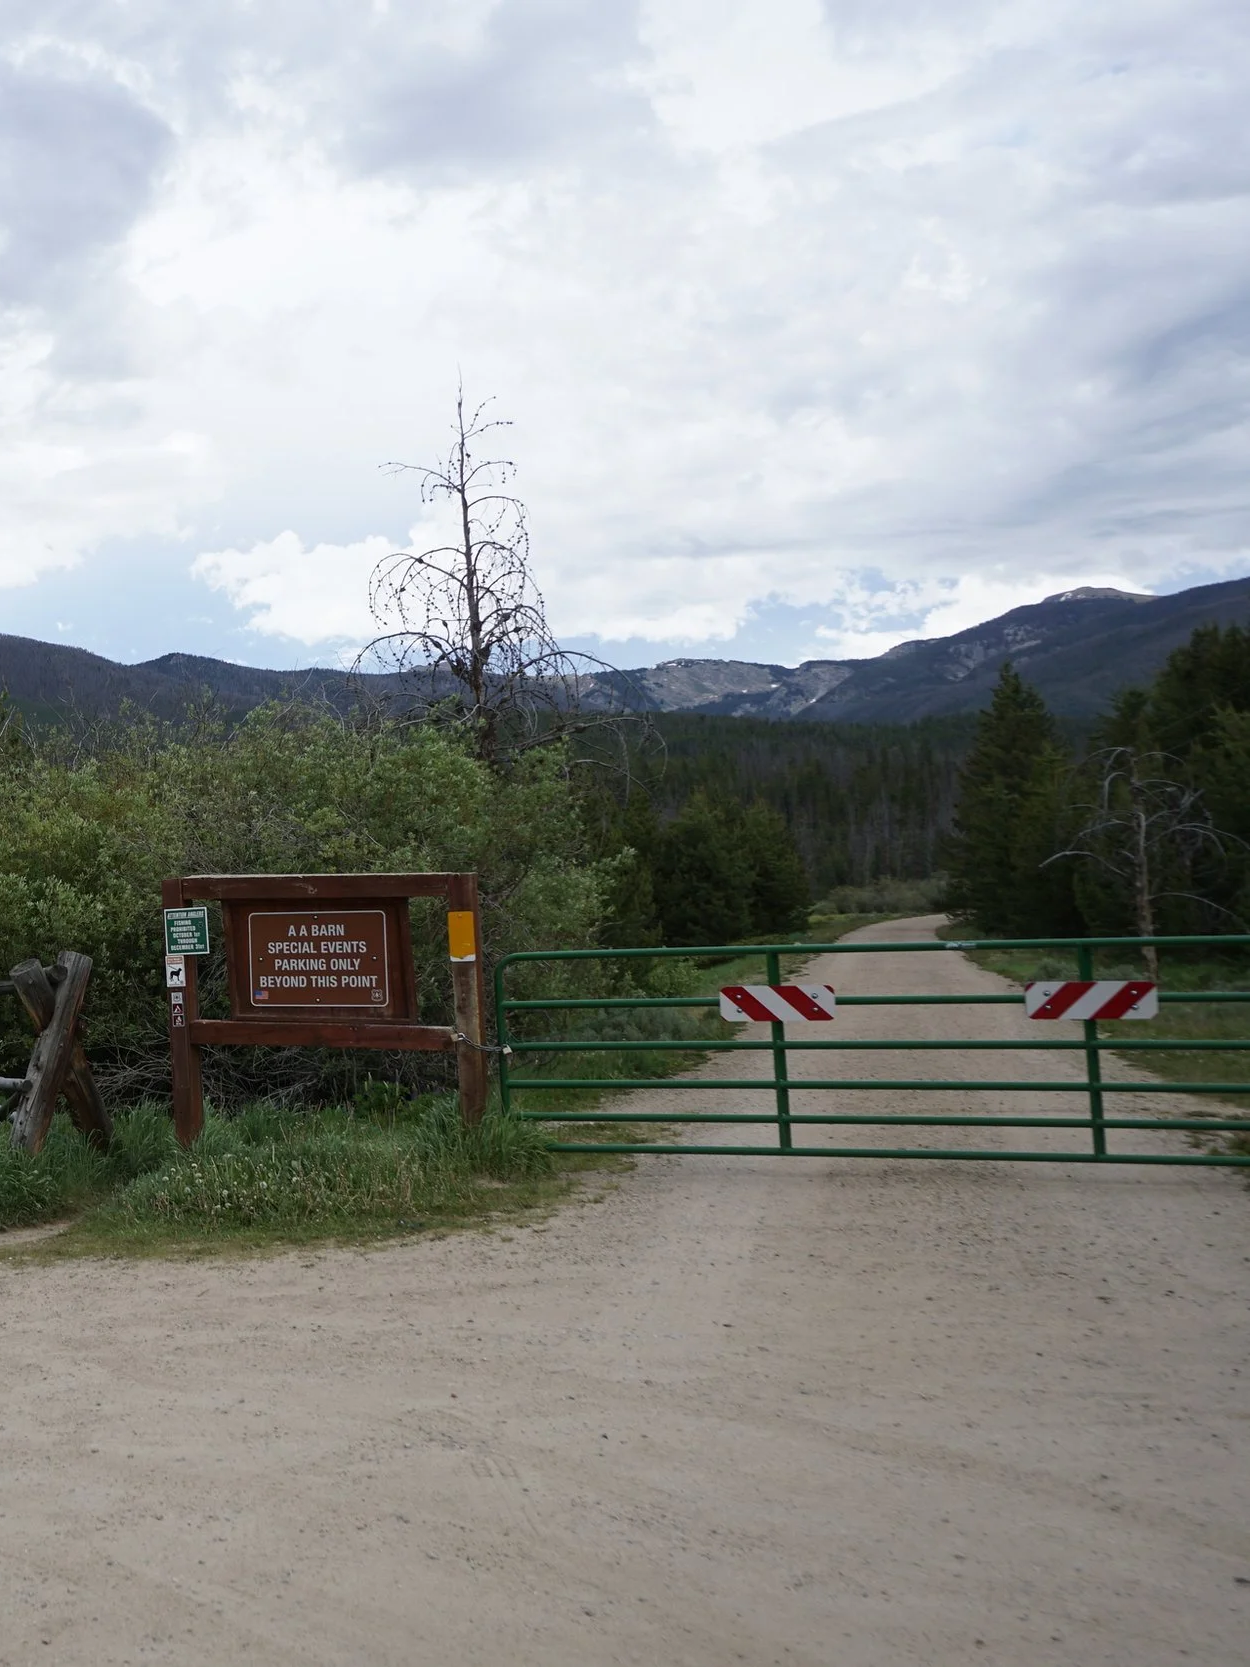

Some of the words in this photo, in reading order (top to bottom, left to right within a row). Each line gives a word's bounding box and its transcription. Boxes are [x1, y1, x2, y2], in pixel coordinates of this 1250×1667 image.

[288, 925, 296, 937] A
[300, 925, 308, 936] A
[312, 925, 344, 936] BARN
[268, 942, 317, 953] SPECIAL
[321, 941, 367, 953] EVENTS
[275, 959, 326, 970] PARKING
[330, 959, 360, 970] ONLY
[260, 976, 307, 988] BEYOND
[310, 976, 338, 987] THIS
[342, 976, 377, 987] POINT
